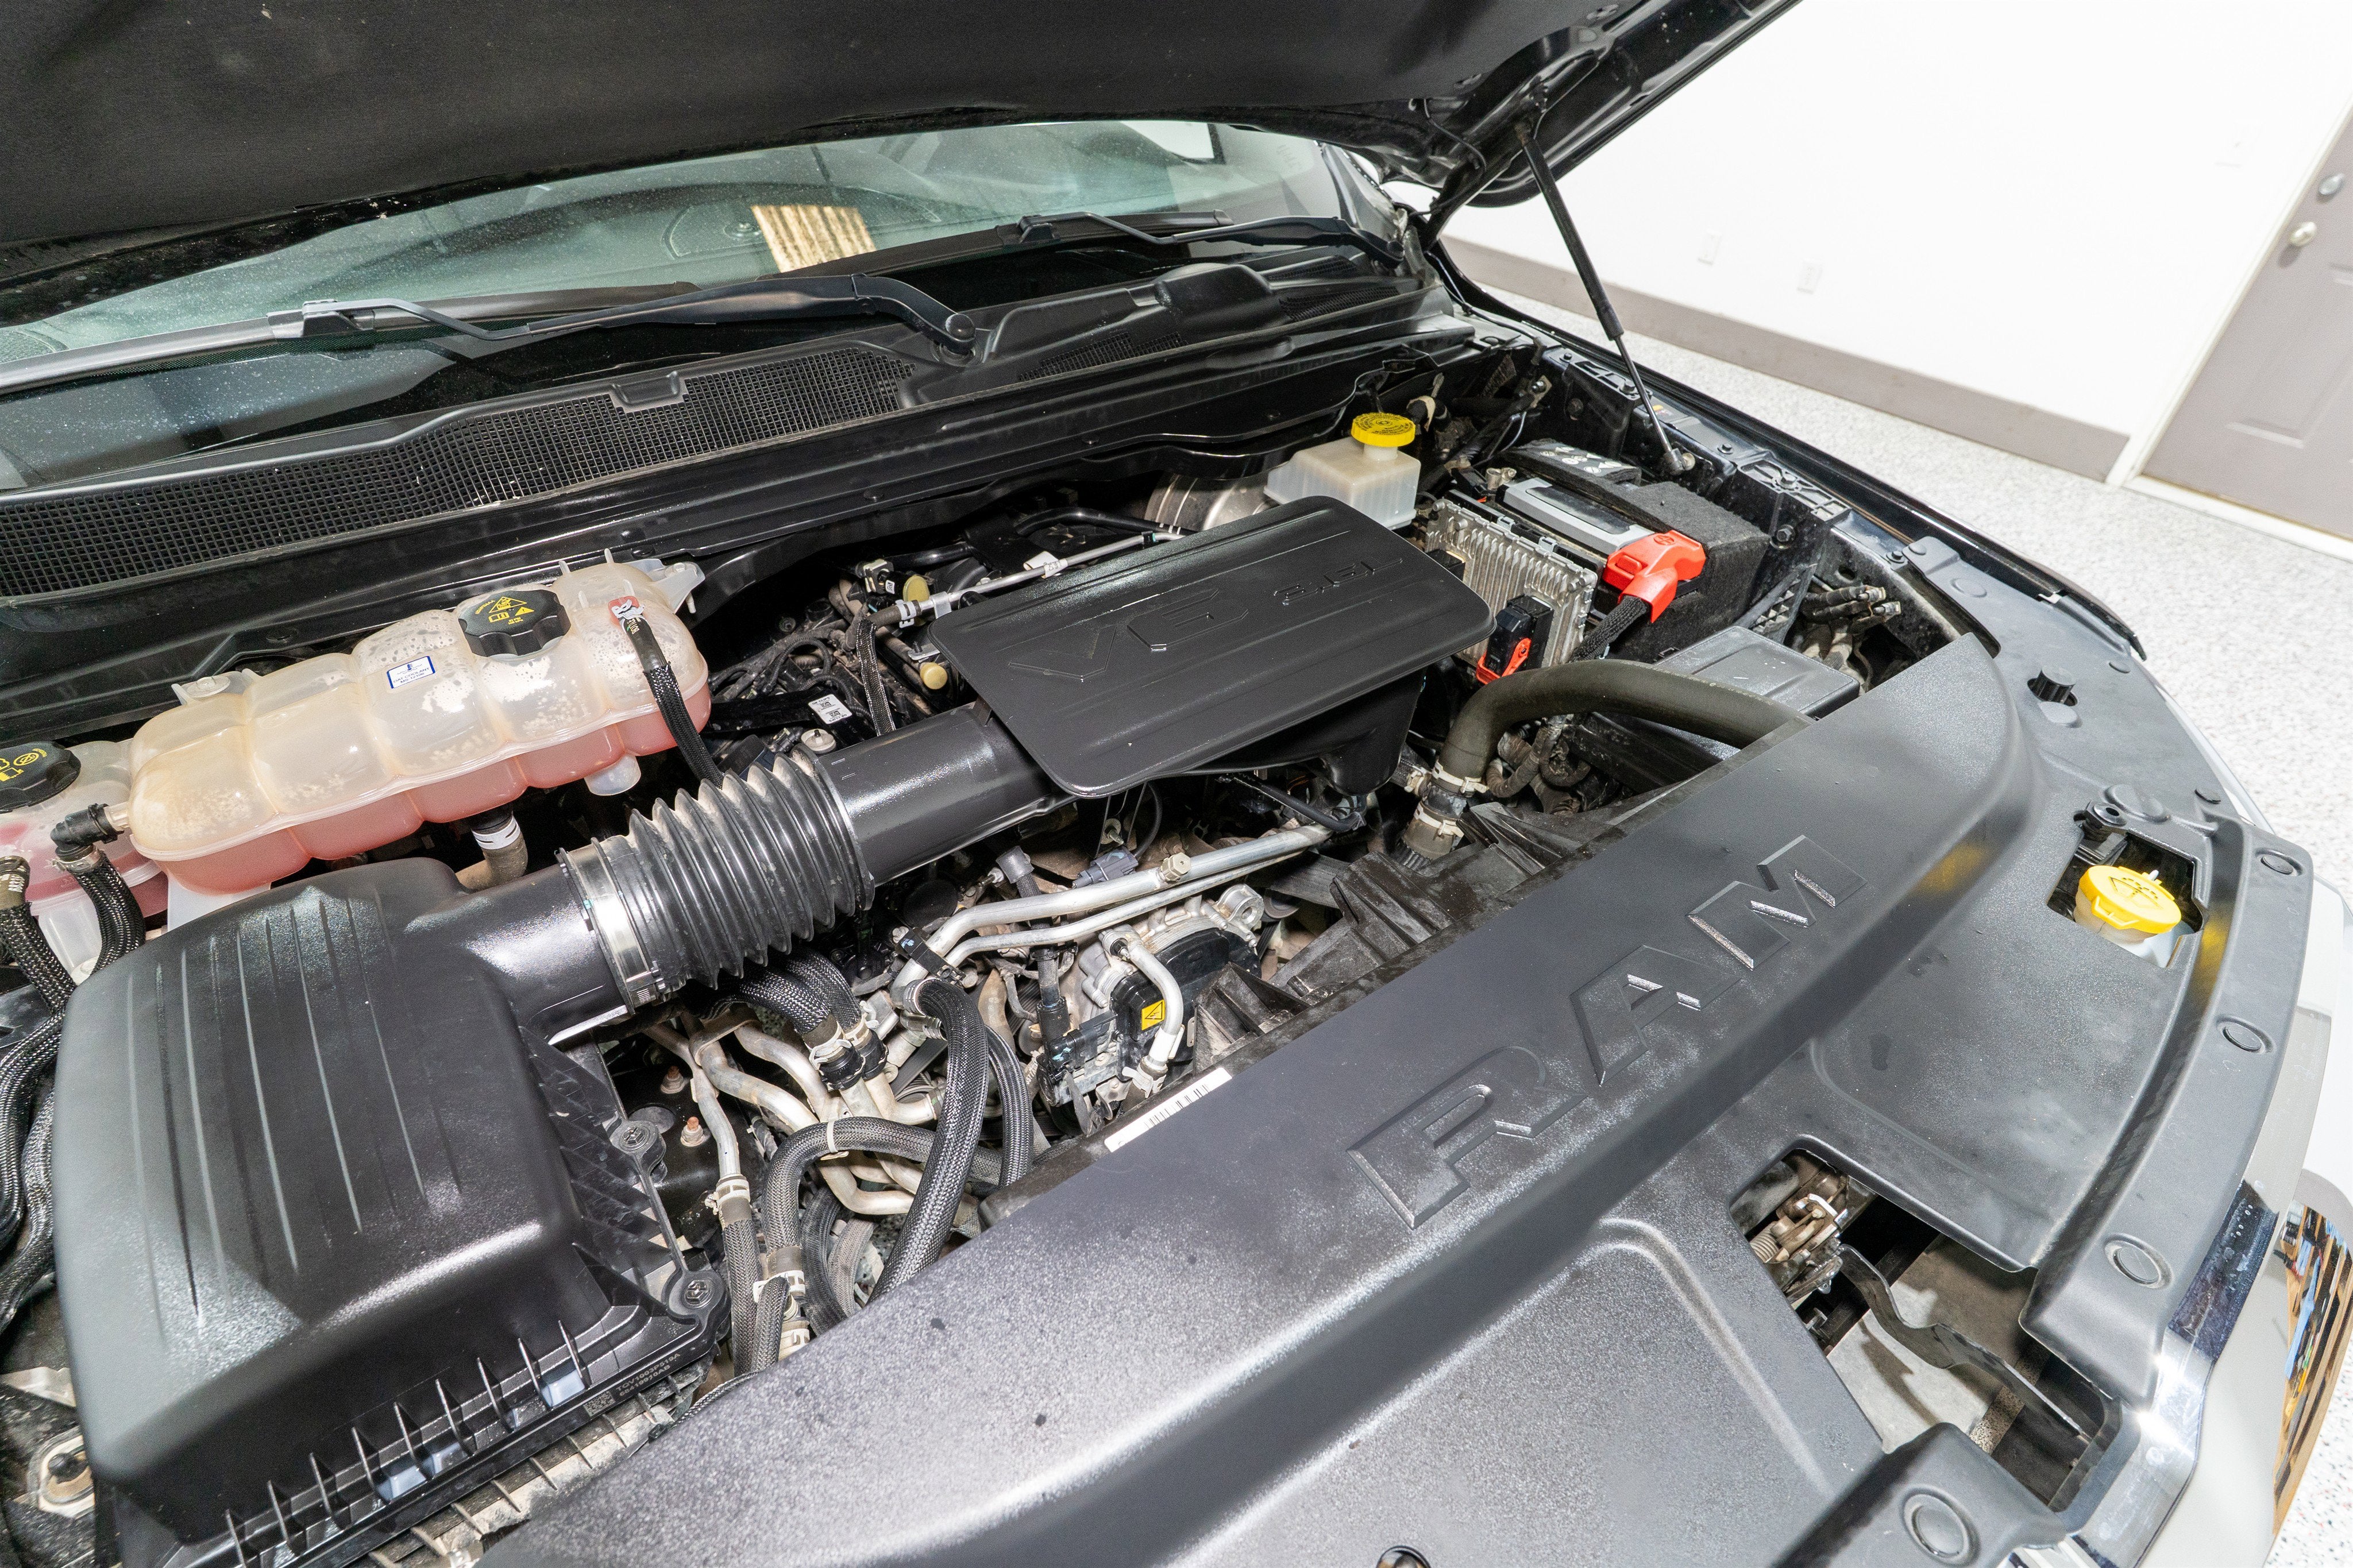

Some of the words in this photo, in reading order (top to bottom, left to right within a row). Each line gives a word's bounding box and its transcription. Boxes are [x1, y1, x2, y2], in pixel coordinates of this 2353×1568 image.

[404, 667, 430, 678] COOLANT
[1009, 587, 1249, 682] V6
[1346, 835, 1868, 1230] RAM
